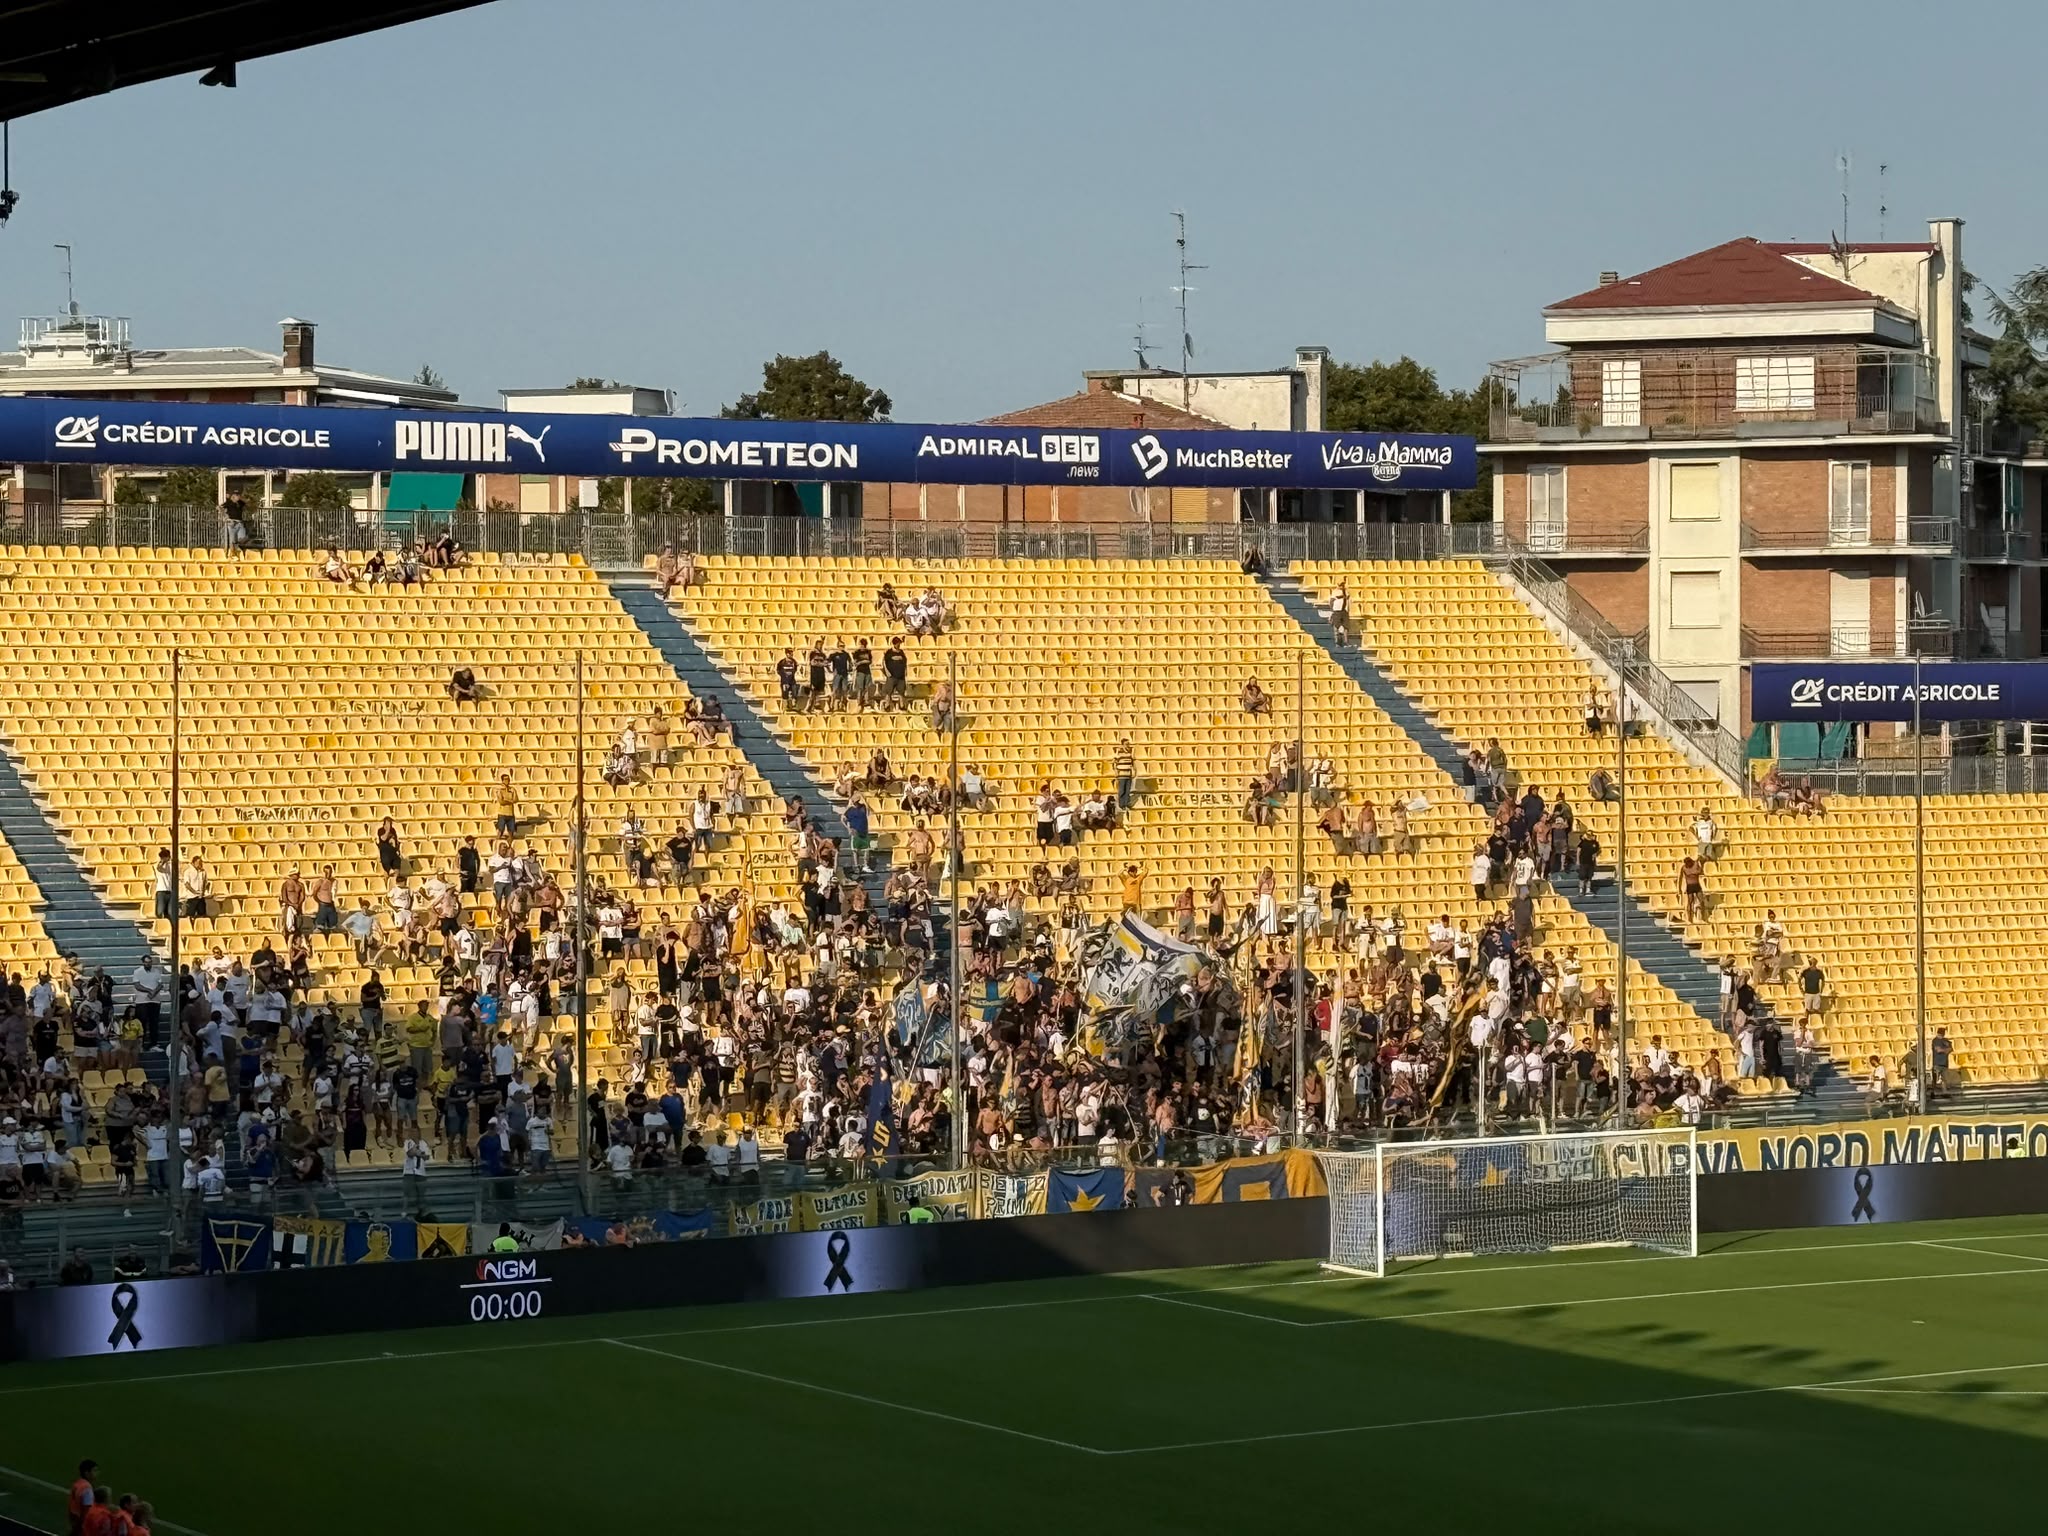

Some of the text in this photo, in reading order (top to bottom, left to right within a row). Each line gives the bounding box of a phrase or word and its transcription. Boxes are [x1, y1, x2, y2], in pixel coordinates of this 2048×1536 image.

[103, 421, 330, 448] CRÉDIT AGRICOLE
[395, 420, 506, 462] PUMA
[619, 429, 858, 468] PROMETEON
[1176, 448, 1293, 469] MuchBetter
[1321, 438, 1453, 470] Viva la Mamma
[1827, 681, 2000, 702] CRÉDIT AGRICOLE
[1759, 1129, 1871, 1171] NORD
[812, 1189, 868, 1215] ULTRAS
[483, 1258, 537, 1281] NGM
[470, 1290, 542, 1322] 00:00
